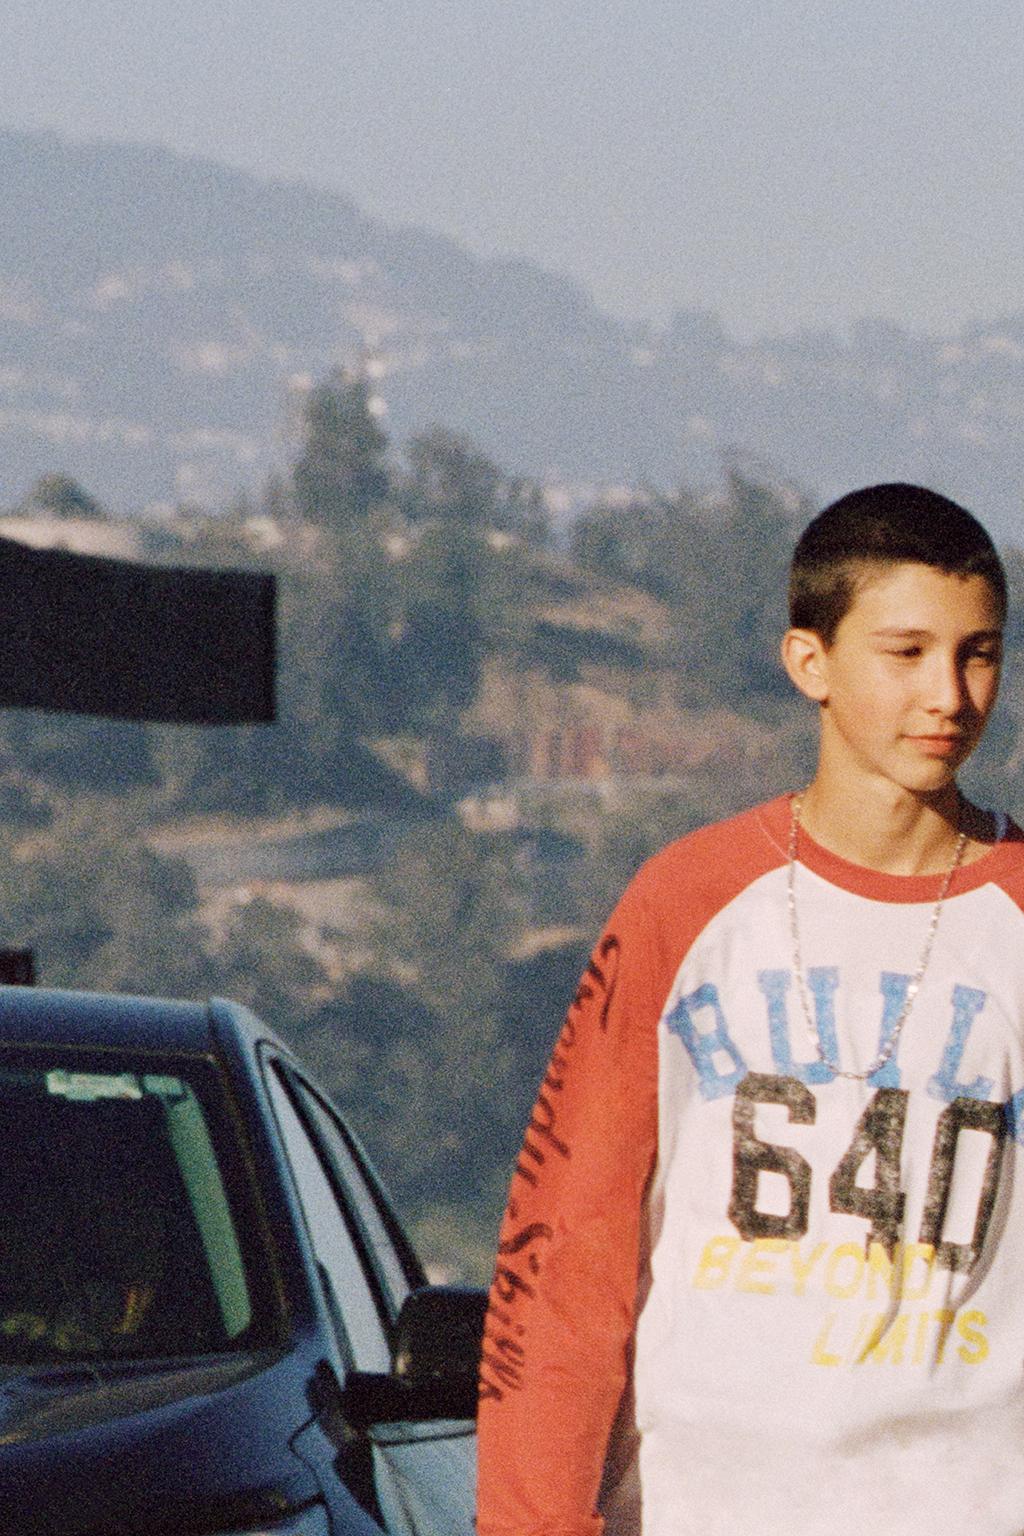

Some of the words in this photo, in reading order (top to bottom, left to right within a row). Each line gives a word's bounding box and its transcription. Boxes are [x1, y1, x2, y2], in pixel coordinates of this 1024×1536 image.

[727, 1071, 1015, 1276] 640
[692, 1236, 937, 1300] BEYOND
[810, 1309, 990, 1366] LIMITS
